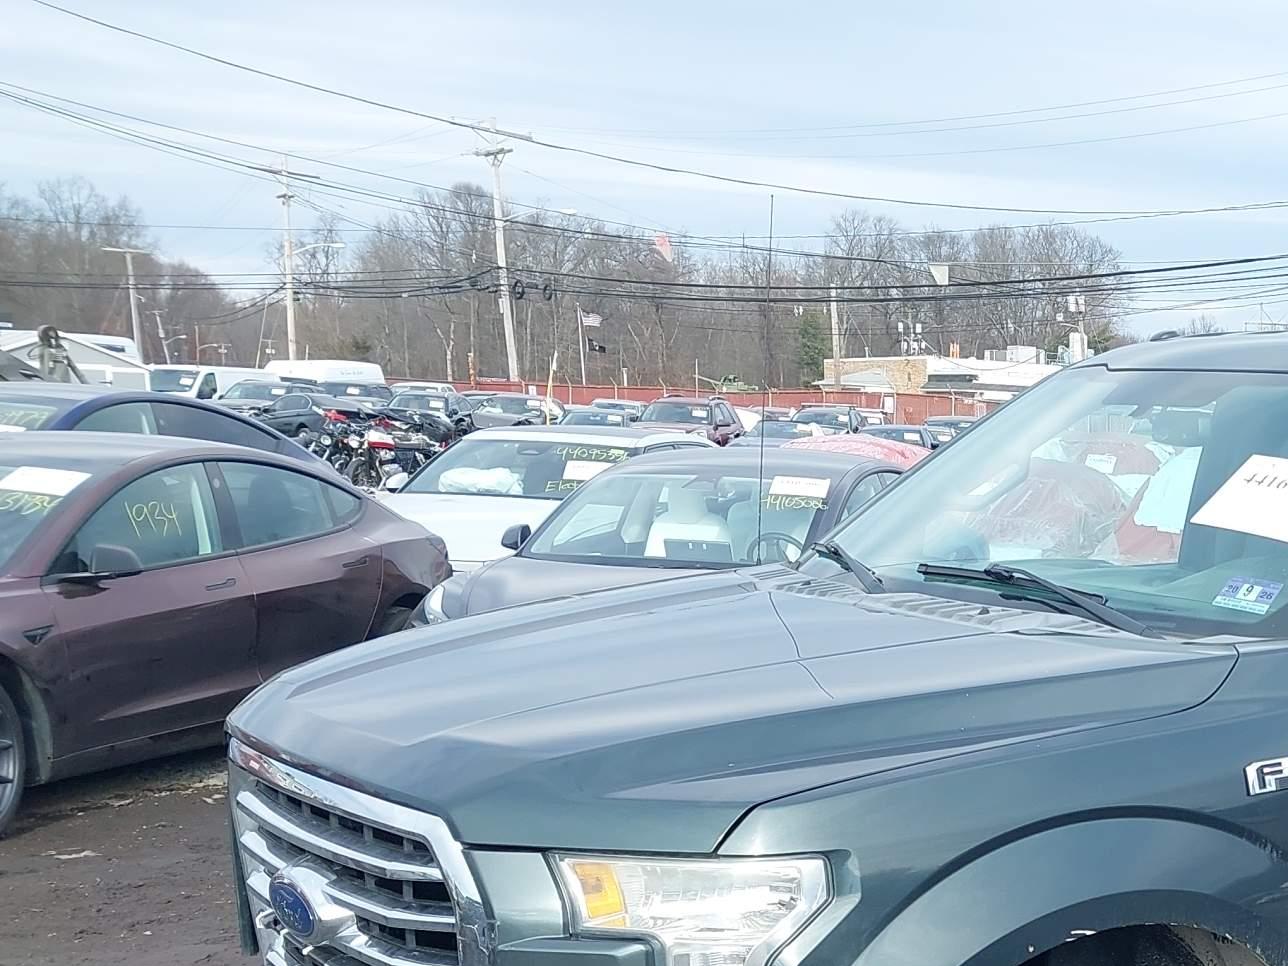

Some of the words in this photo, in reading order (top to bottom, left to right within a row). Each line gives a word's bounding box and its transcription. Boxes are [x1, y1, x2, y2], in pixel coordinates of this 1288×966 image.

[124, 501, 182, 537] 1934
[1243, 585, 1254, 597] 9
[1260, 591, 1274, 600] 26
